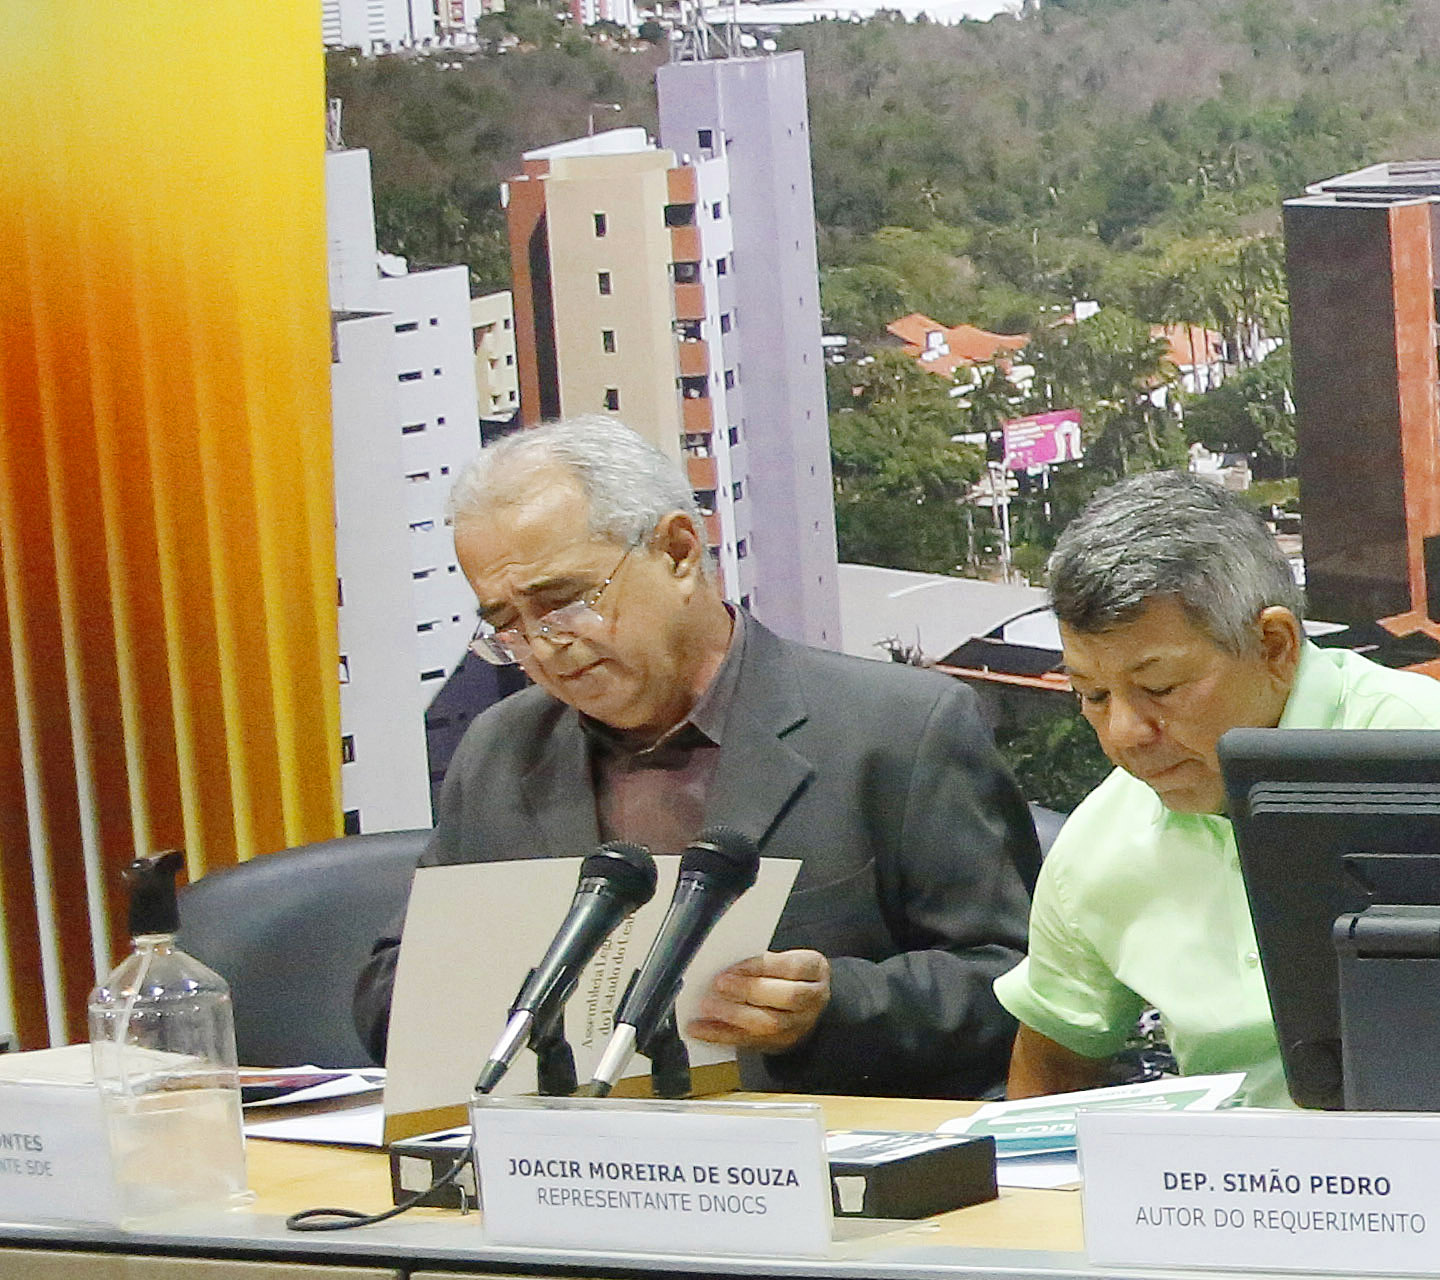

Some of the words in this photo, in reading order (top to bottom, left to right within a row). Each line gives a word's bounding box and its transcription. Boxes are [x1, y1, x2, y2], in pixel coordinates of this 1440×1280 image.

[0, 1132, 43, 1152] NTES
[509, 1158, 583, 1179] JOACIR
[589, 1161, 686, 1183] MOREIRA
[693, 1165, 721, 1185] DE
[727, 1166, 800, 1187] SOUZA
[1163, 1171, 1215, 1192] DEP.
[1223, 1168, 1301, 1194] SIMÃO
[1310, 1175, 1391, 1196] PEDRO
[537, 1187, 692, 1212] REPRESENTANTE
[698, 1193, 768, 1215] DNOCS
[1135, 1206, 1207, 1227] AUTOR
[1213, 1208, 1245, 1229] DO
[1253, 1209, 1426, 1235] REQUERIMENTO
